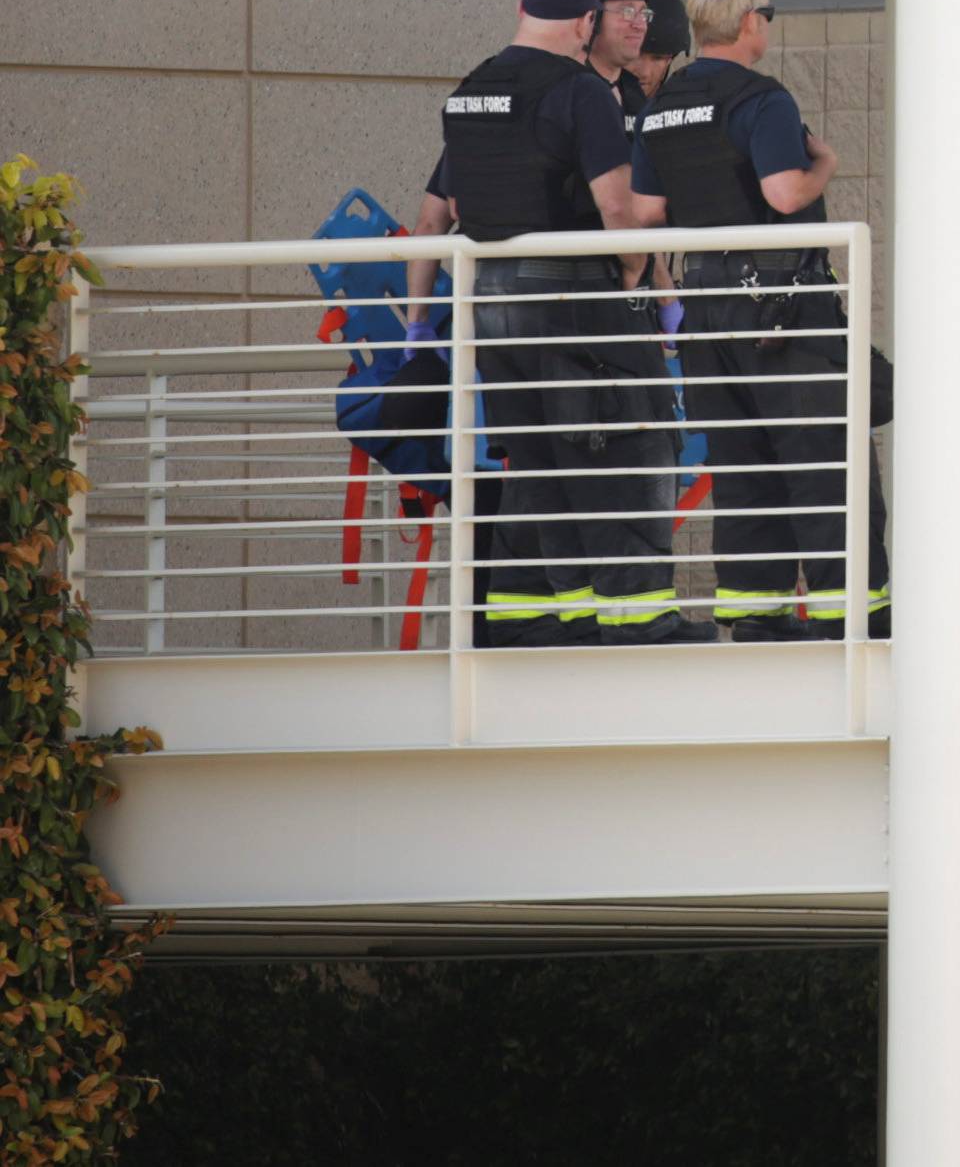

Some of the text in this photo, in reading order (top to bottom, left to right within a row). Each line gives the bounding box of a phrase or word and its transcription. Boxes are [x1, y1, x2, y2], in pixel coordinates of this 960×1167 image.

[466, 97, 484, 113] TASK
[484, 96, 511, 113] FORCE
[663, 109, 685, 127] TASK
[684, 105, 714, 124] FORCE
